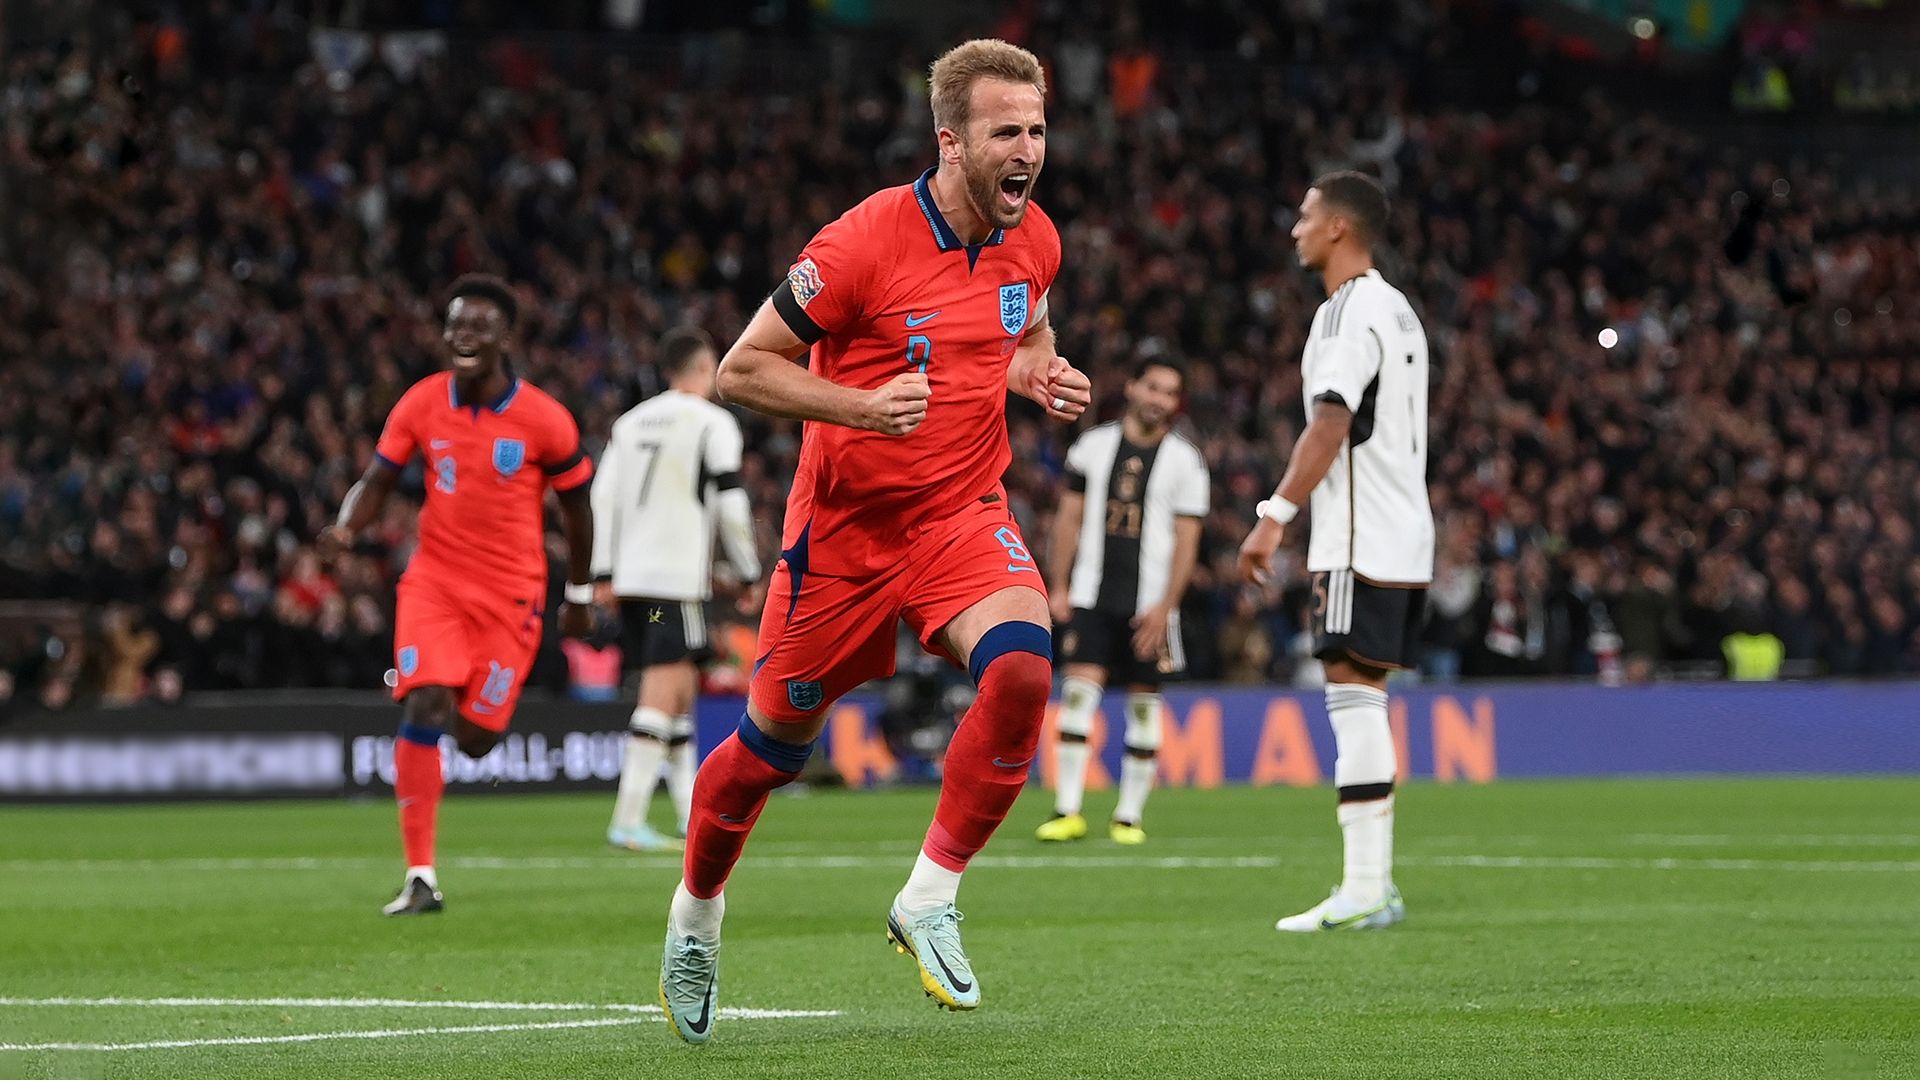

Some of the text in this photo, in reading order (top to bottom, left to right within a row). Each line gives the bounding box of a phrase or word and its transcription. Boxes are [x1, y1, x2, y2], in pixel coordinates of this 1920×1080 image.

[638, 441, 661, 509] 7
[994, 526, 1031, 562] 9
[480, 659, 515, 706] 18
